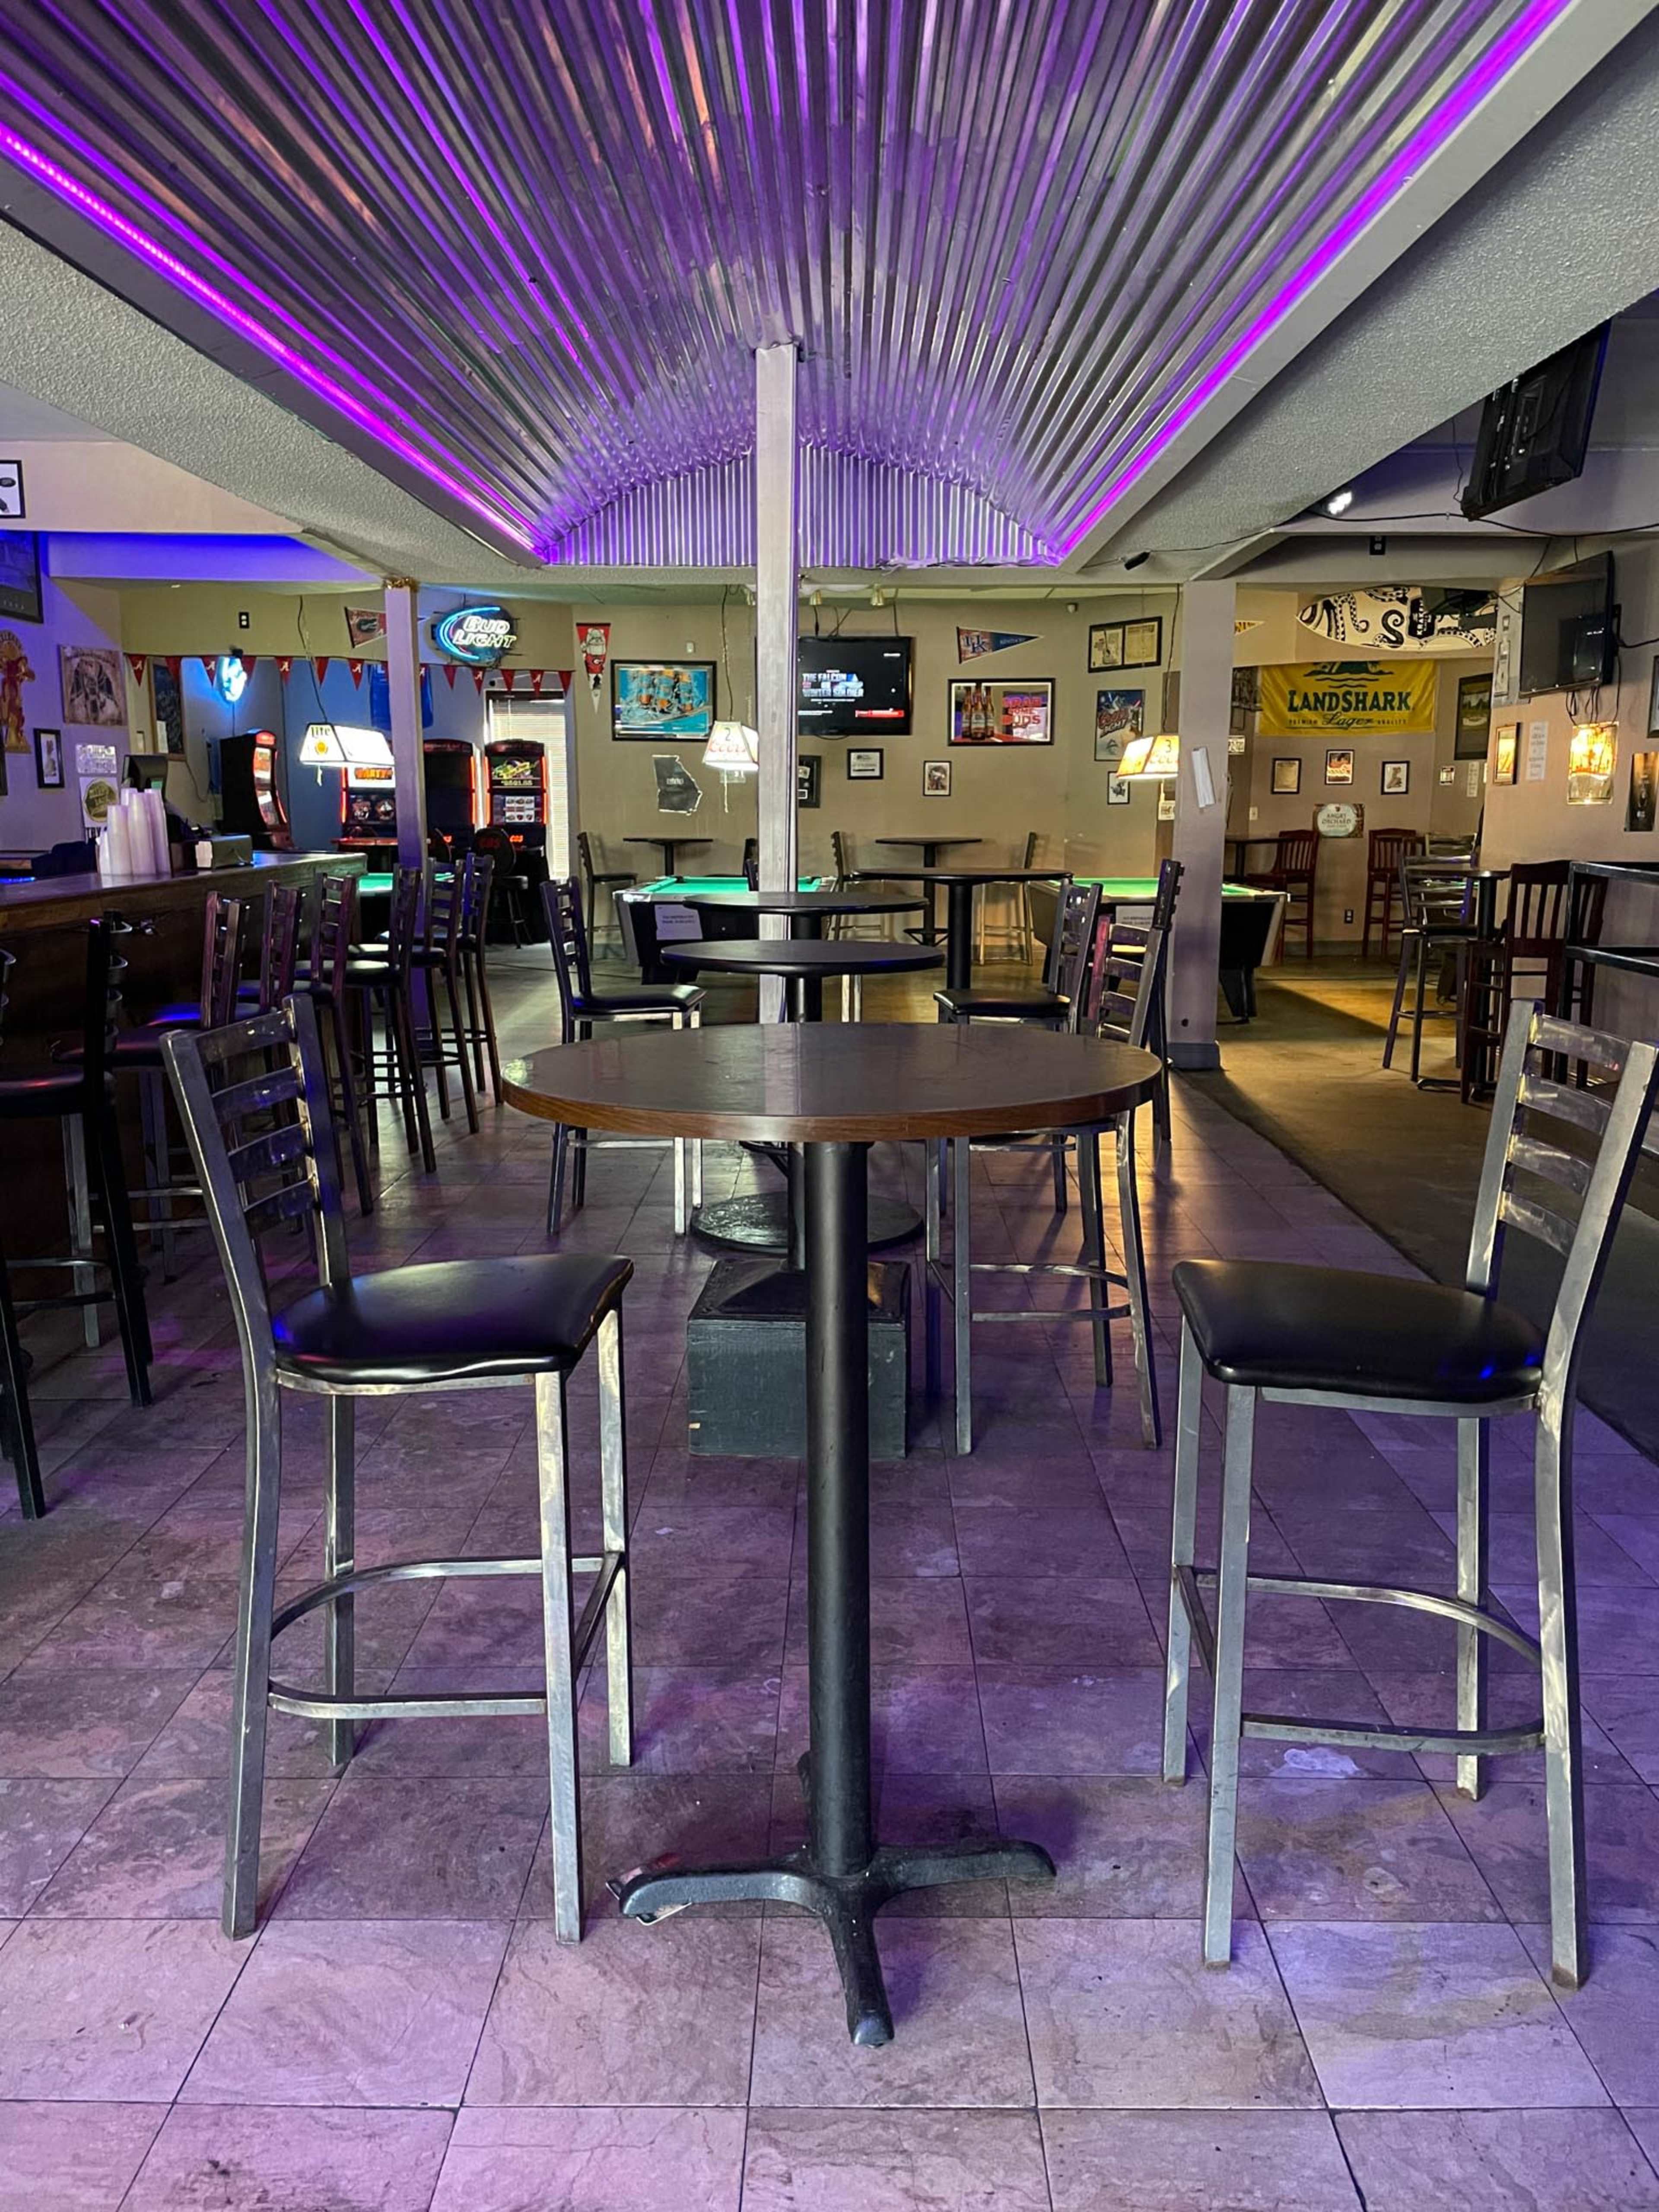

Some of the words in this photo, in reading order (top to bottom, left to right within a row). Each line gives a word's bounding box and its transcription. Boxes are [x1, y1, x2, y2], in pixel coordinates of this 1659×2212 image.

[463, 616, 510, 634] BUD
[453, 629, 517, 648] LIGHT
[1288, 690, 1411, 712] LANDSHARK
[1322, 711, 1374, 730] Lager
[725, 728, 731, 741] 2
